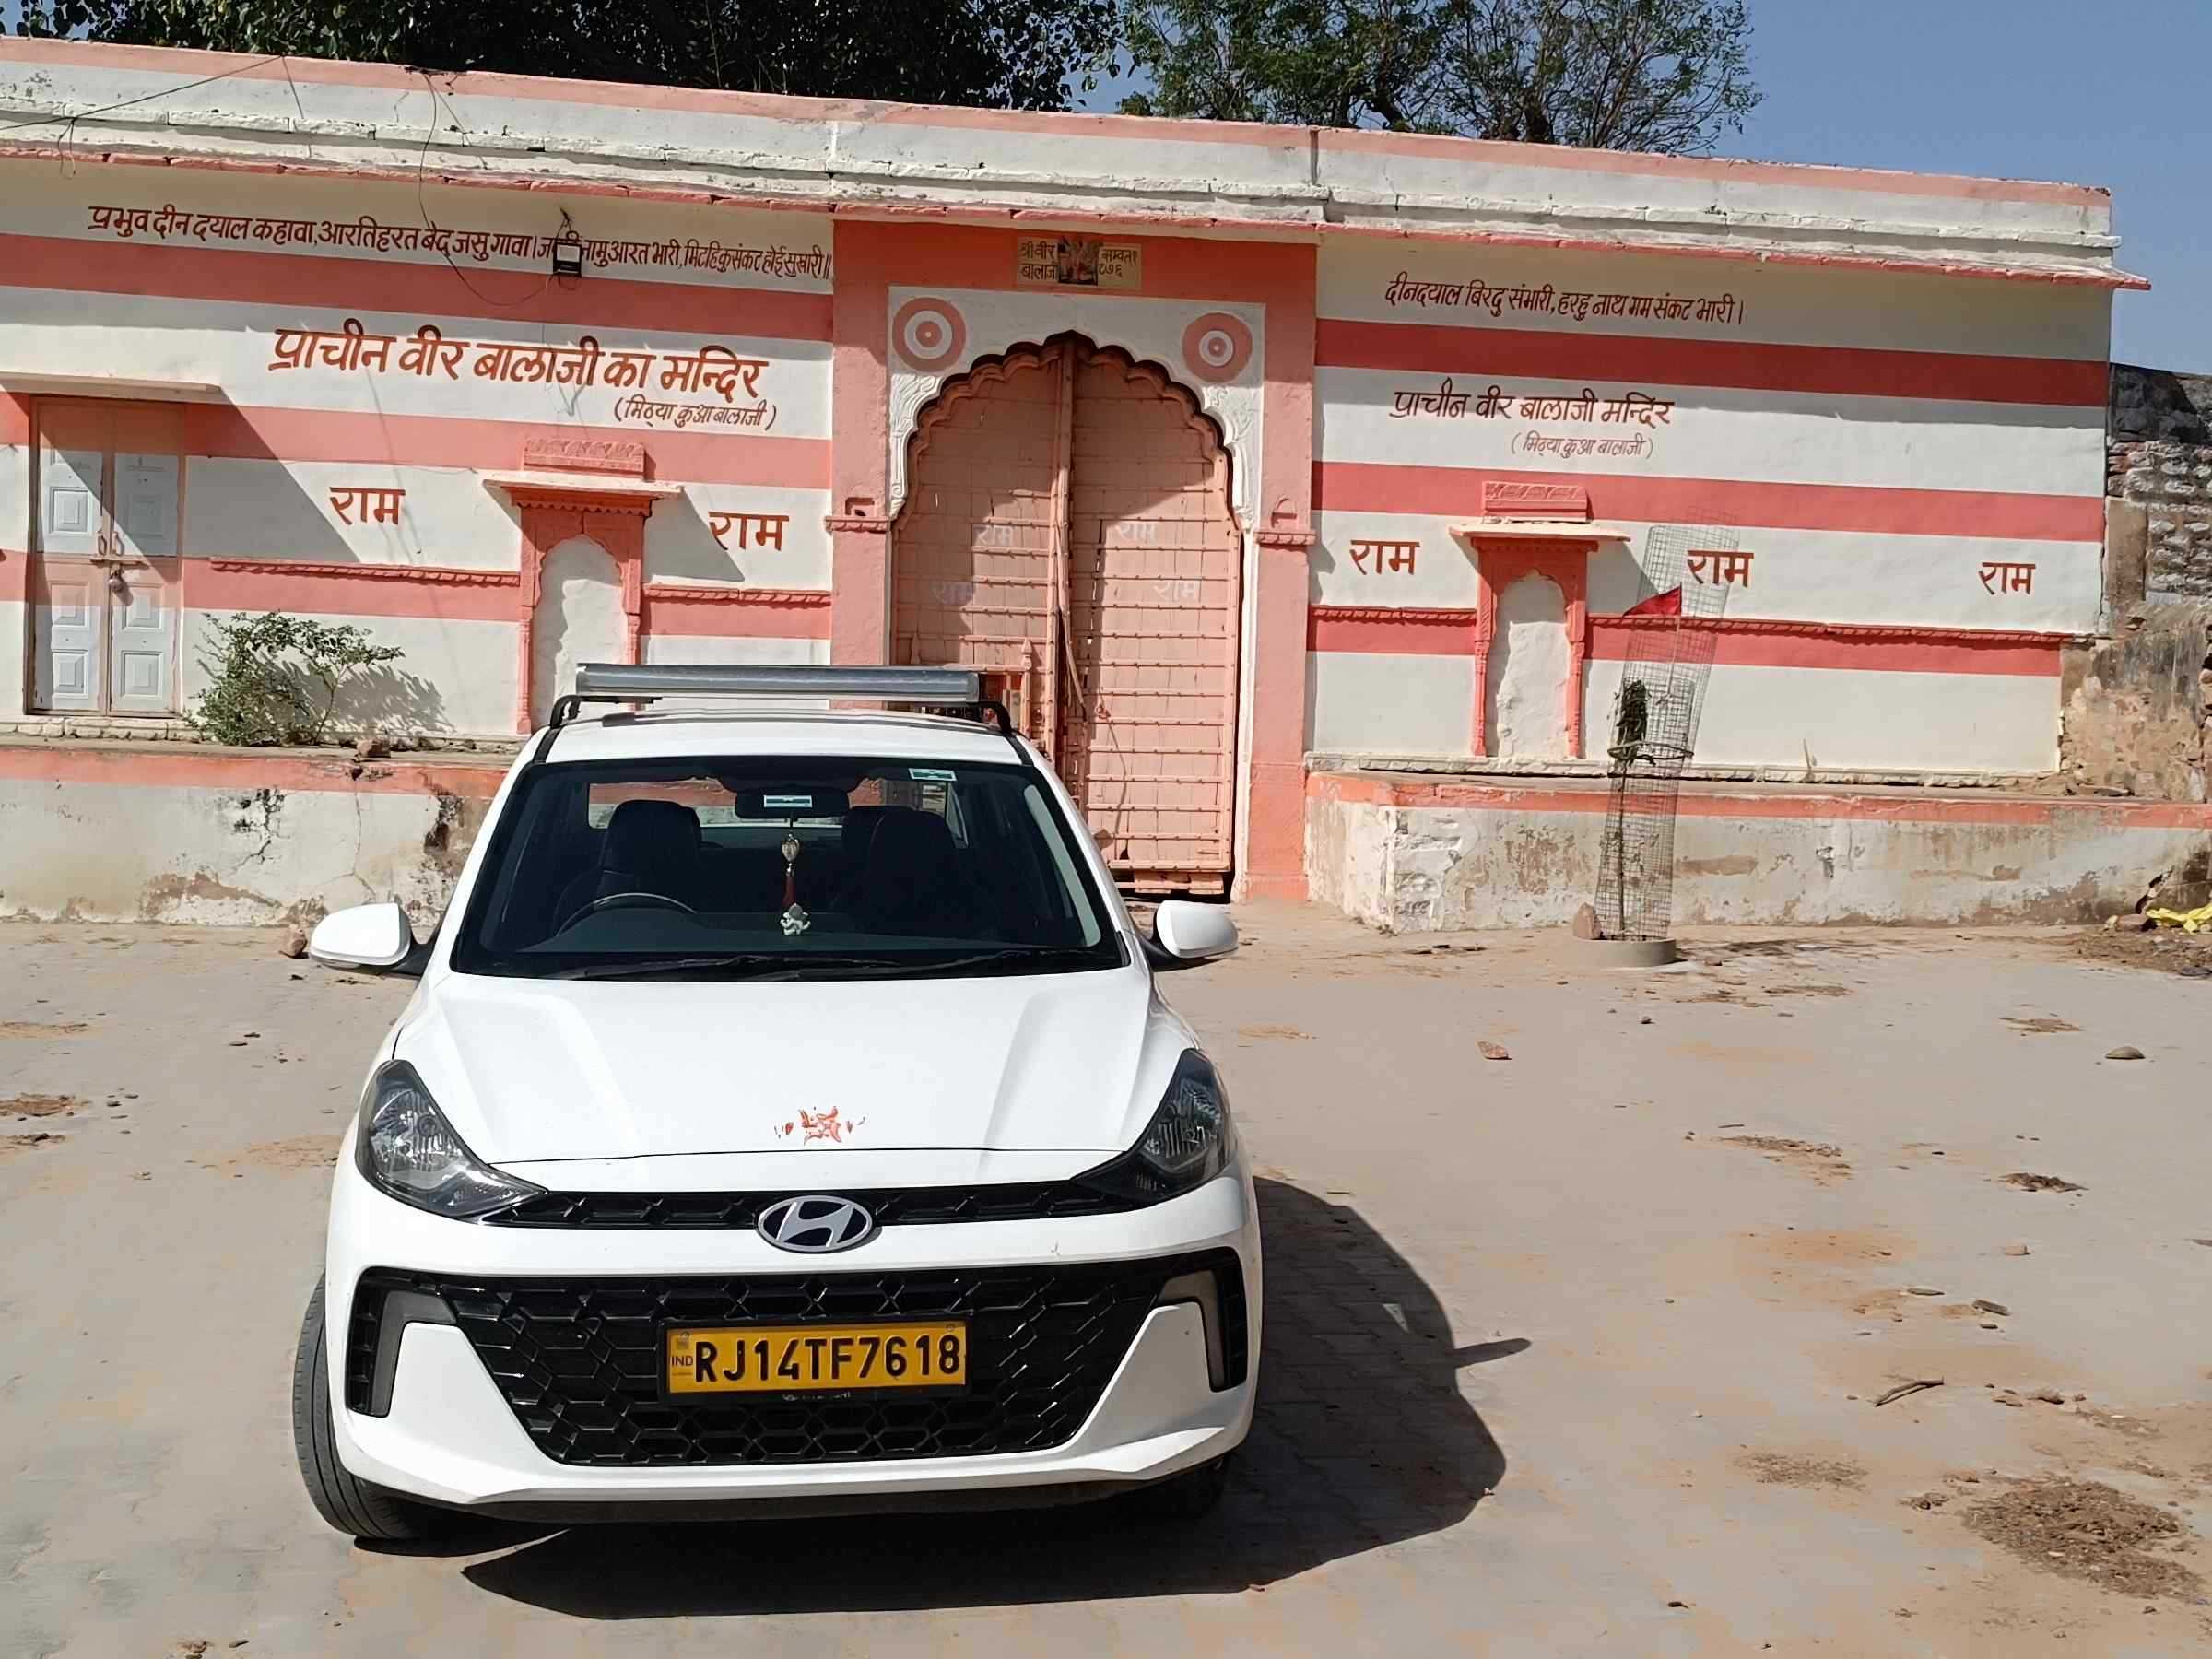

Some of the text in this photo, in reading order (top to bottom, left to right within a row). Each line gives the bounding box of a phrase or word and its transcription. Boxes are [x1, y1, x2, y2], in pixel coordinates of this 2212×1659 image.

[154, 204, 194, 239] दीन
[193, 214, 253, 241] दयाल
[453, 231, 490, 261] जसु
[1593, 294, 1629, 317] नाथ
[1653, 292, 1695, 321] संकट
[268, 317, 769, 403] प्राचीन वीर बालाजी का मन्दिर
[1389, 377, 1675, 429] प्राचीन वीर बालाजी मन्दिर
[329, 487, 406, 525] राम
[708, 511, 790, 551] राम
[1349, 539, 1420, 576] राम
[1688, 550, 1754, 588] राम
[1978, 562, 2036, 595] राम
[671, 1356, 693, 1367] IND
[695, 1333, 960, 1382] RJ14TF7618
